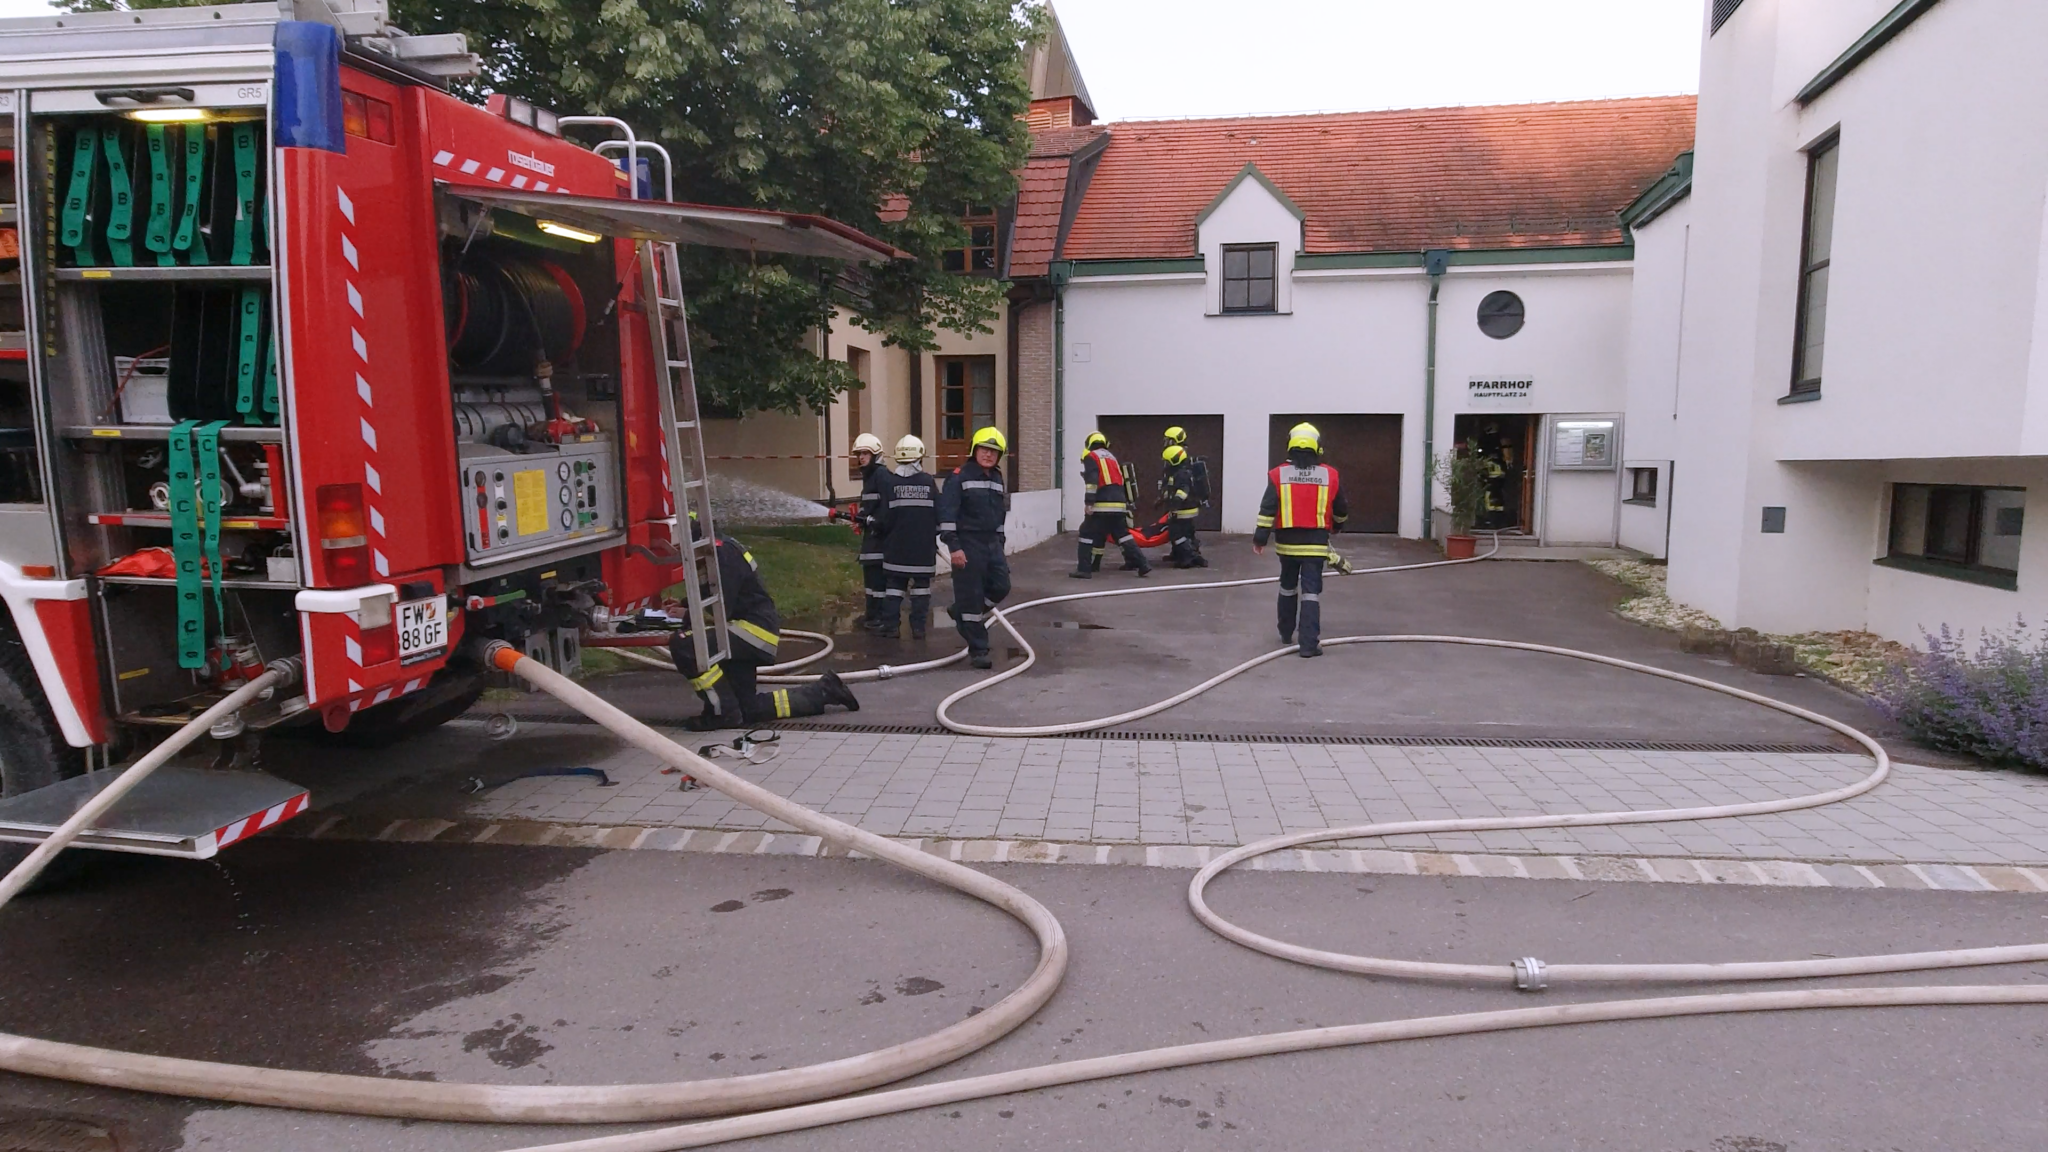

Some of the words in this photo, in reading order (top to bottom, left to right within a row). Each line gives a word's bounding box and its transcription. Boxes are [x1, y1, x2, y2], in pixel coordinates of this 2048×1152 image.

[238, 88, 262, 98] GR5
[1469, 381, 1533, 389] PFARRHOF
[894, 485, 930, 493] FEUERWEHR
[402, 604, 424, 628] FW
[402, 628, 421, 650] 88
[424, 622, 442, 644] GF
